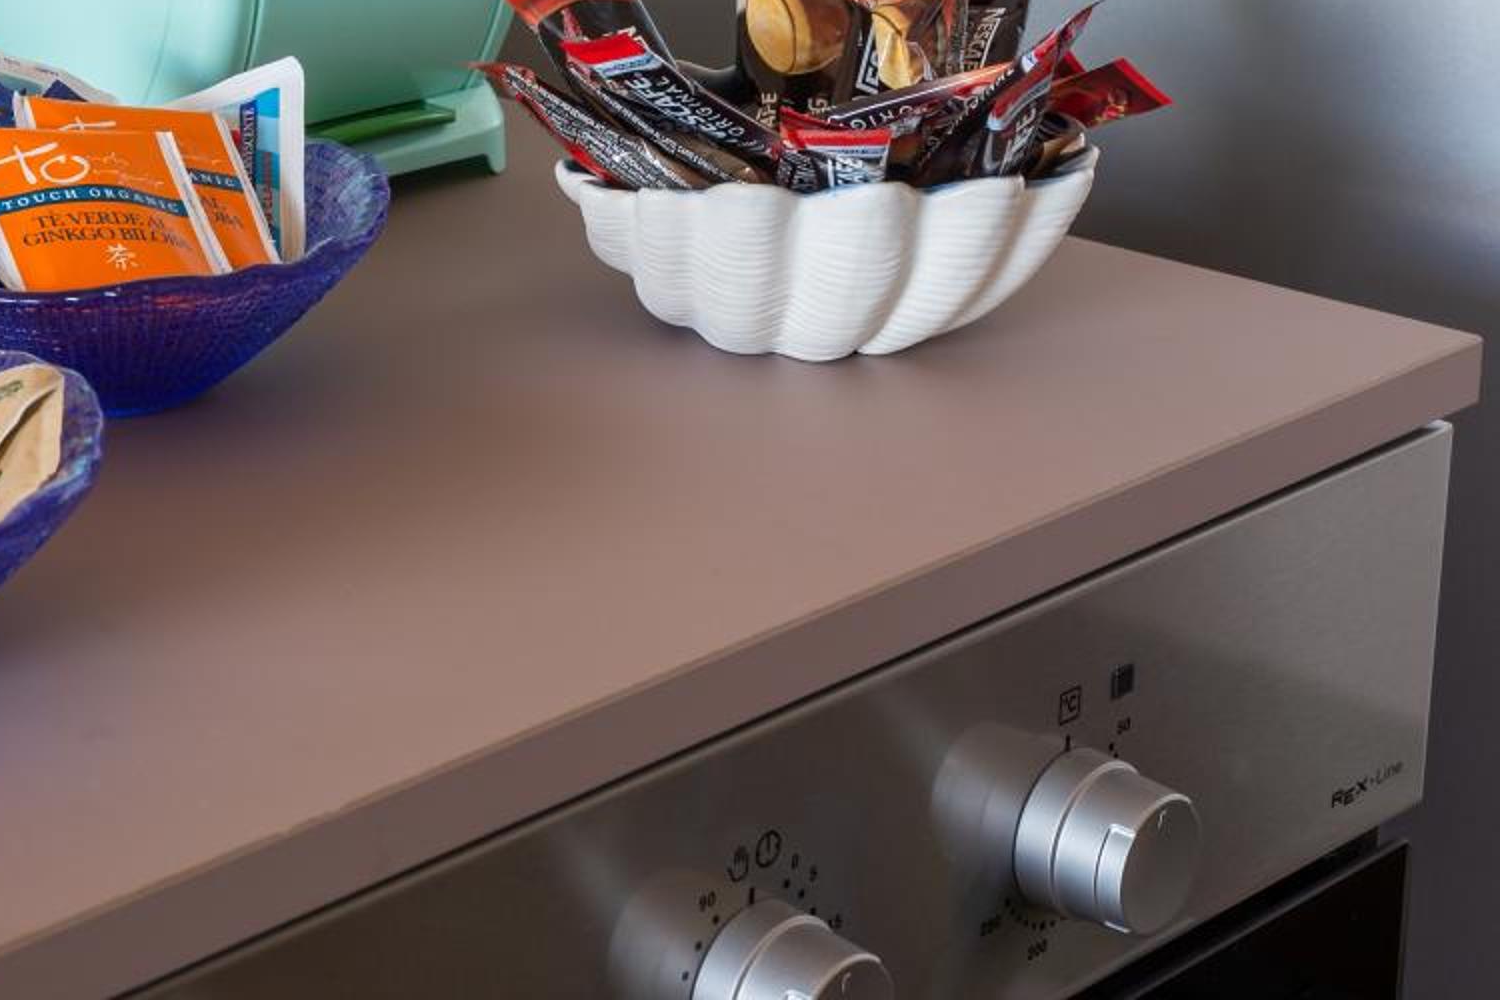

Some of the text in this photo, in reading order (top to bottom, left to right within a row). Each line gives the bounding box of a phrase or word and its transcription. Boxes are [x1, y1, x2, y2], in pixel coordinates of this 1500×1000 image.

[0, 187, 80, 212] TOUCH
[88, 188, 181, 215] ORGANIC
[23, 227, 116, 248] GINKGO
